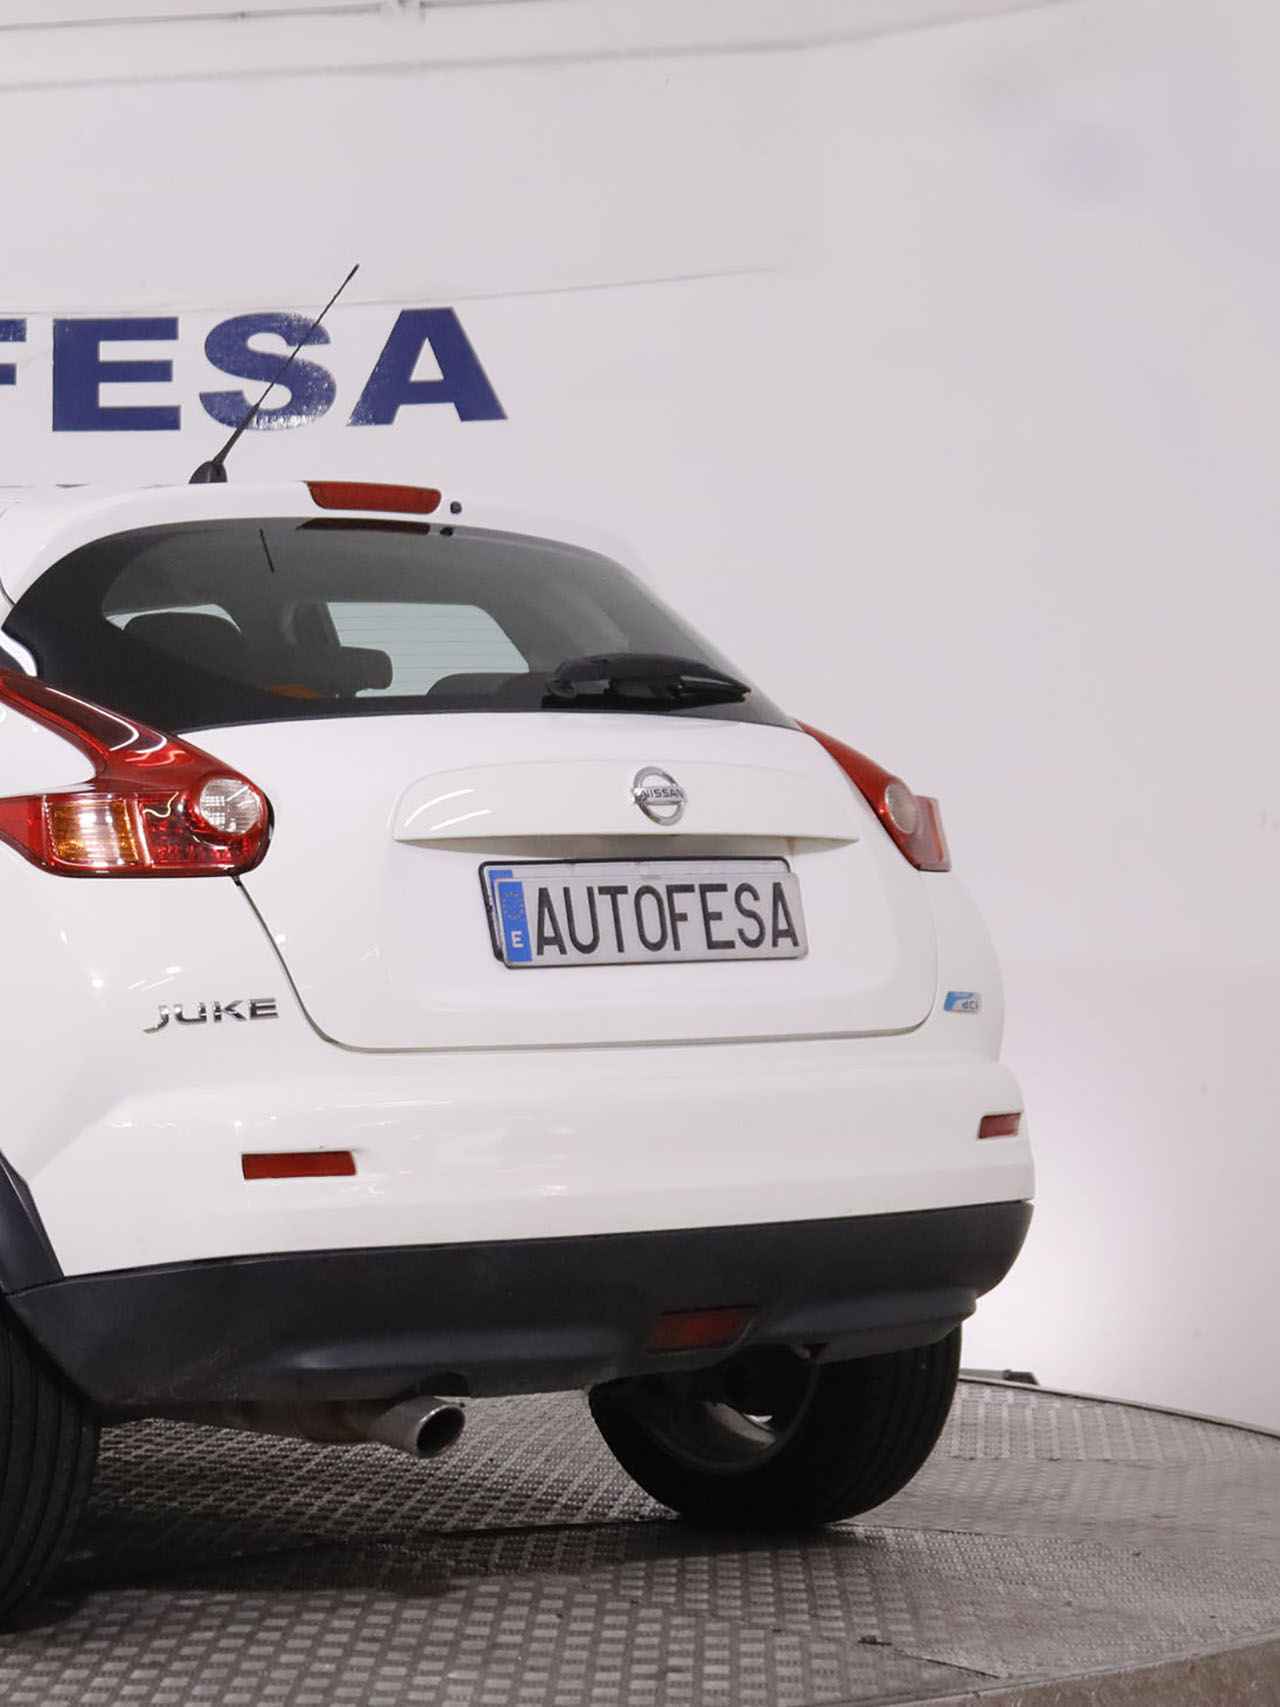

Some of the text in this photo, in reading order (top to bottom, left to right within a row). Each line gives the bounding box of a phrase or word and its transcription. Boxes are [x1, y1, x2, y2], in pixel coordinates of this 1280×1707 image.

[641, 787, 684, 800] NISSAN
[536, 881, 800, 956] AUTOFESA
[511, 930, 525, 948] E
[143, 997, 280, 1034] JUKE
